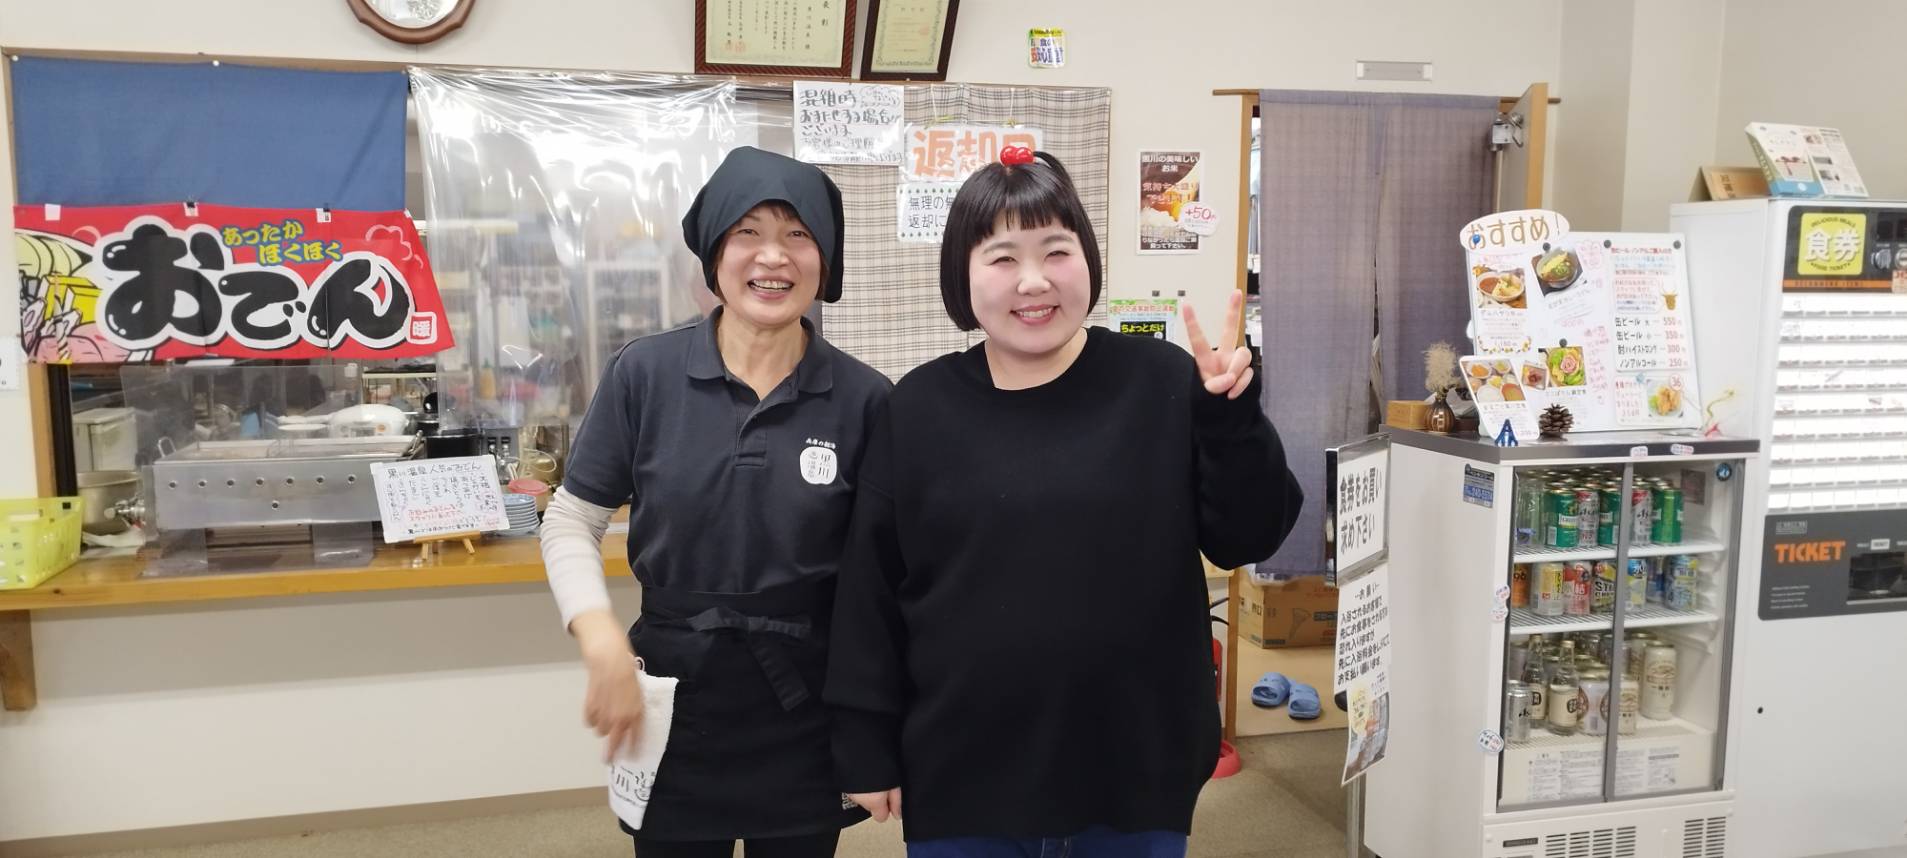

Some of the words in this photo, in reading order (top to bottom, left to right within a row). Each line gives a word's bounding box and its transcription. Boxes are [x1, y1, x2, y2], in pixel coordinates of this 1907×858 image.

[221, 218, 304, 245] あったか
[258, 240, 343, 266] ほくほく
[1804, 228, 1862, 263] 食券
[102, 221, 414, 346] おでん
[1774, 540, 1846, 563] TICKET
